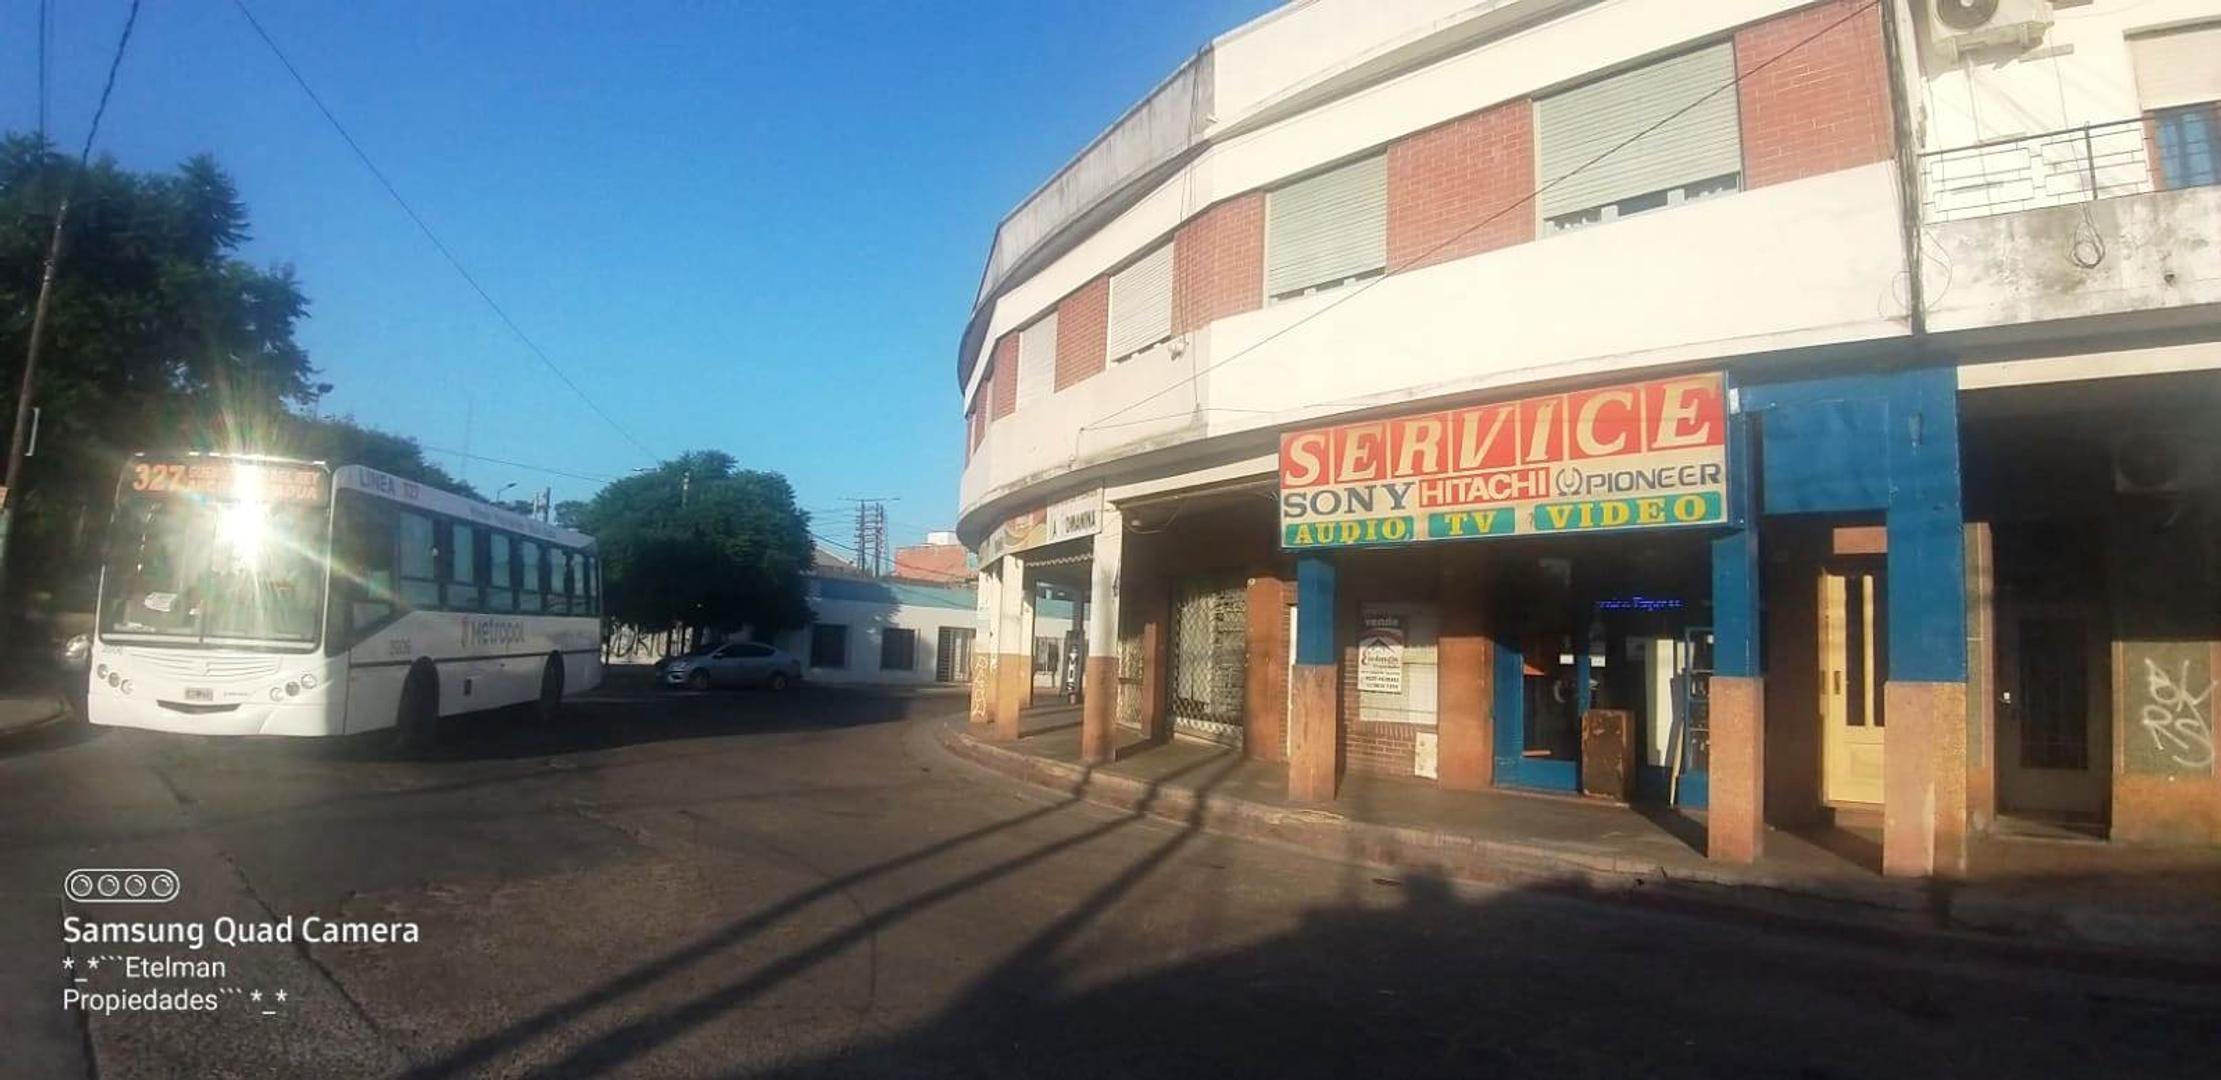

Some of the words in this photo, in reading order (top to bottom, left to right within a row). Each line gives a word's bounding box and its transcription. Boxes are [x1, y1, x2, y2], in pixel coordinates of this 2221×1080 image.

[1284, 379, 1721, 487] SERVICE
[133, 463, 186, 492] 327
[1283, 481, 1416, 519] SONY
[1422, 474, 1549, 507] HITACHI
[1585, 463, 1722, 497] PIONEER
[1293, 517, 1408, 546] AUDIO
[1445, 510, 1499, 536] TV
[1546, 493, 1708, 529] VIDEO
[471, 618, 526, 648] Metropol
